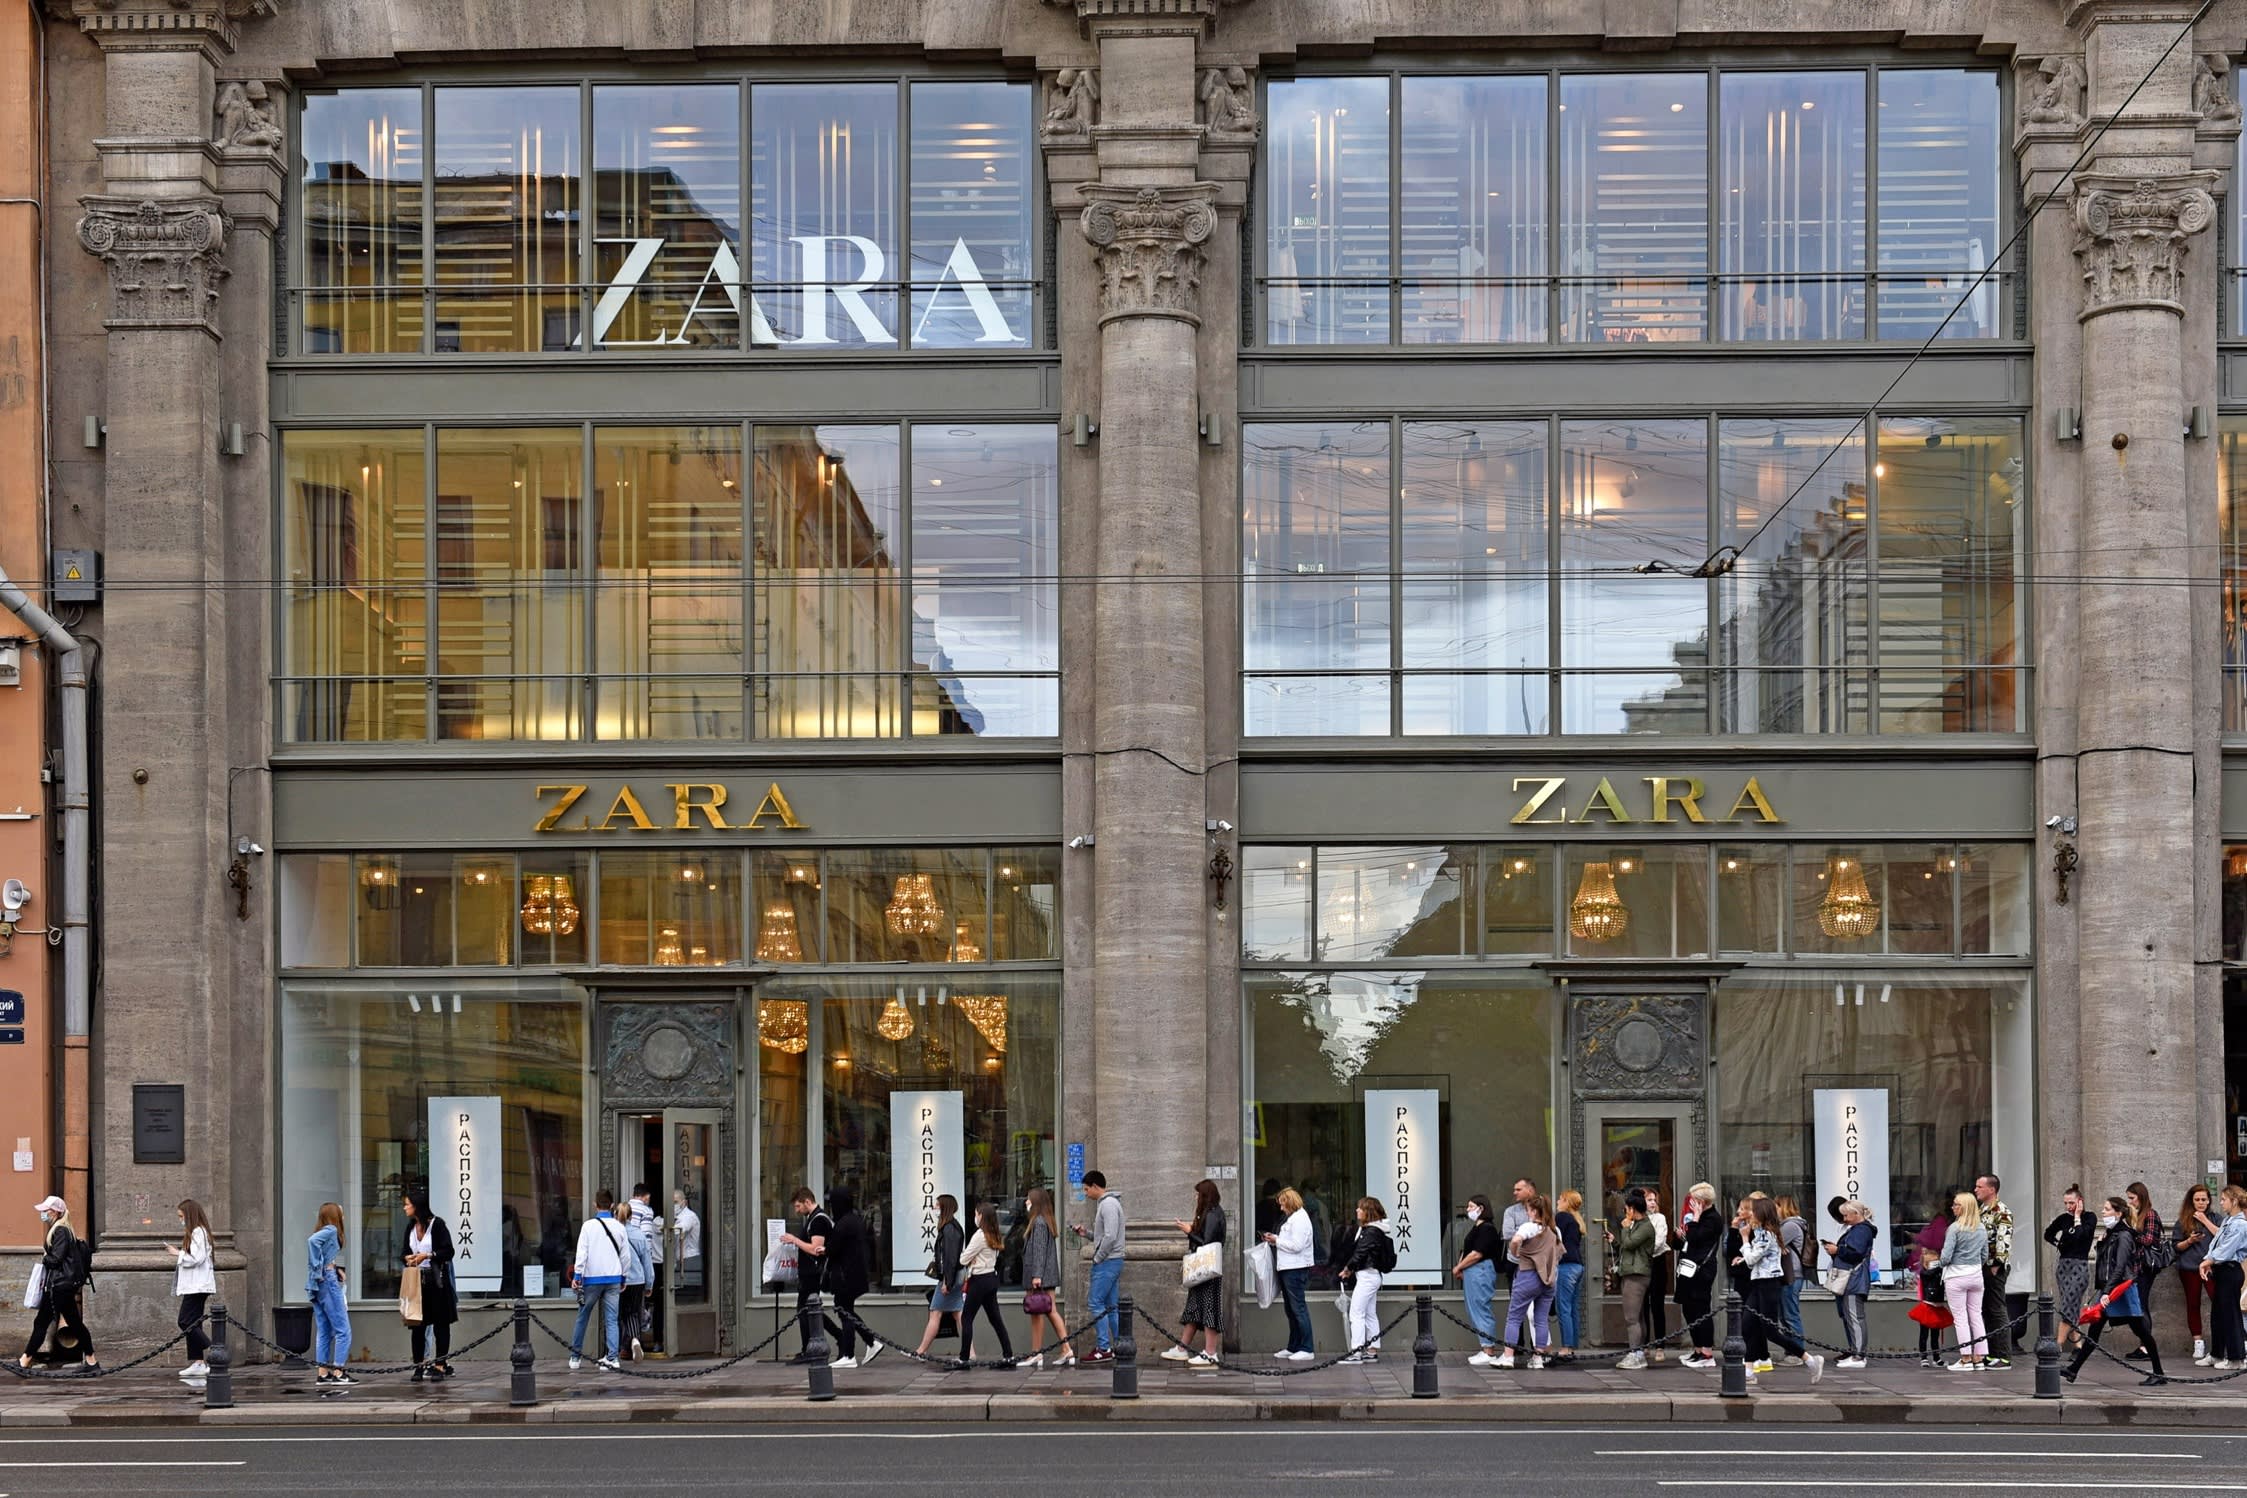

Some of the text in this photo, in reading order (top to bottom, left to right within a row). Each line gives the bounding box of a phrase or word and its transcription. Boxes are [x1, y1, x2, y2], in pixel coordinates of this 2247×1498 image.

[573, 236, 1025, 345] ZARA
[533, 782, 810, 832] ZARA
[1509, 776, 1789, 824] ZARA
[458, 1113, 474, 1259] РАСПРОДАЖА
[921, 1108, 937, 1253] РАСПРОДАЖА
[1396, 1107, 1412, 1253] РАСПРОДАЖА
